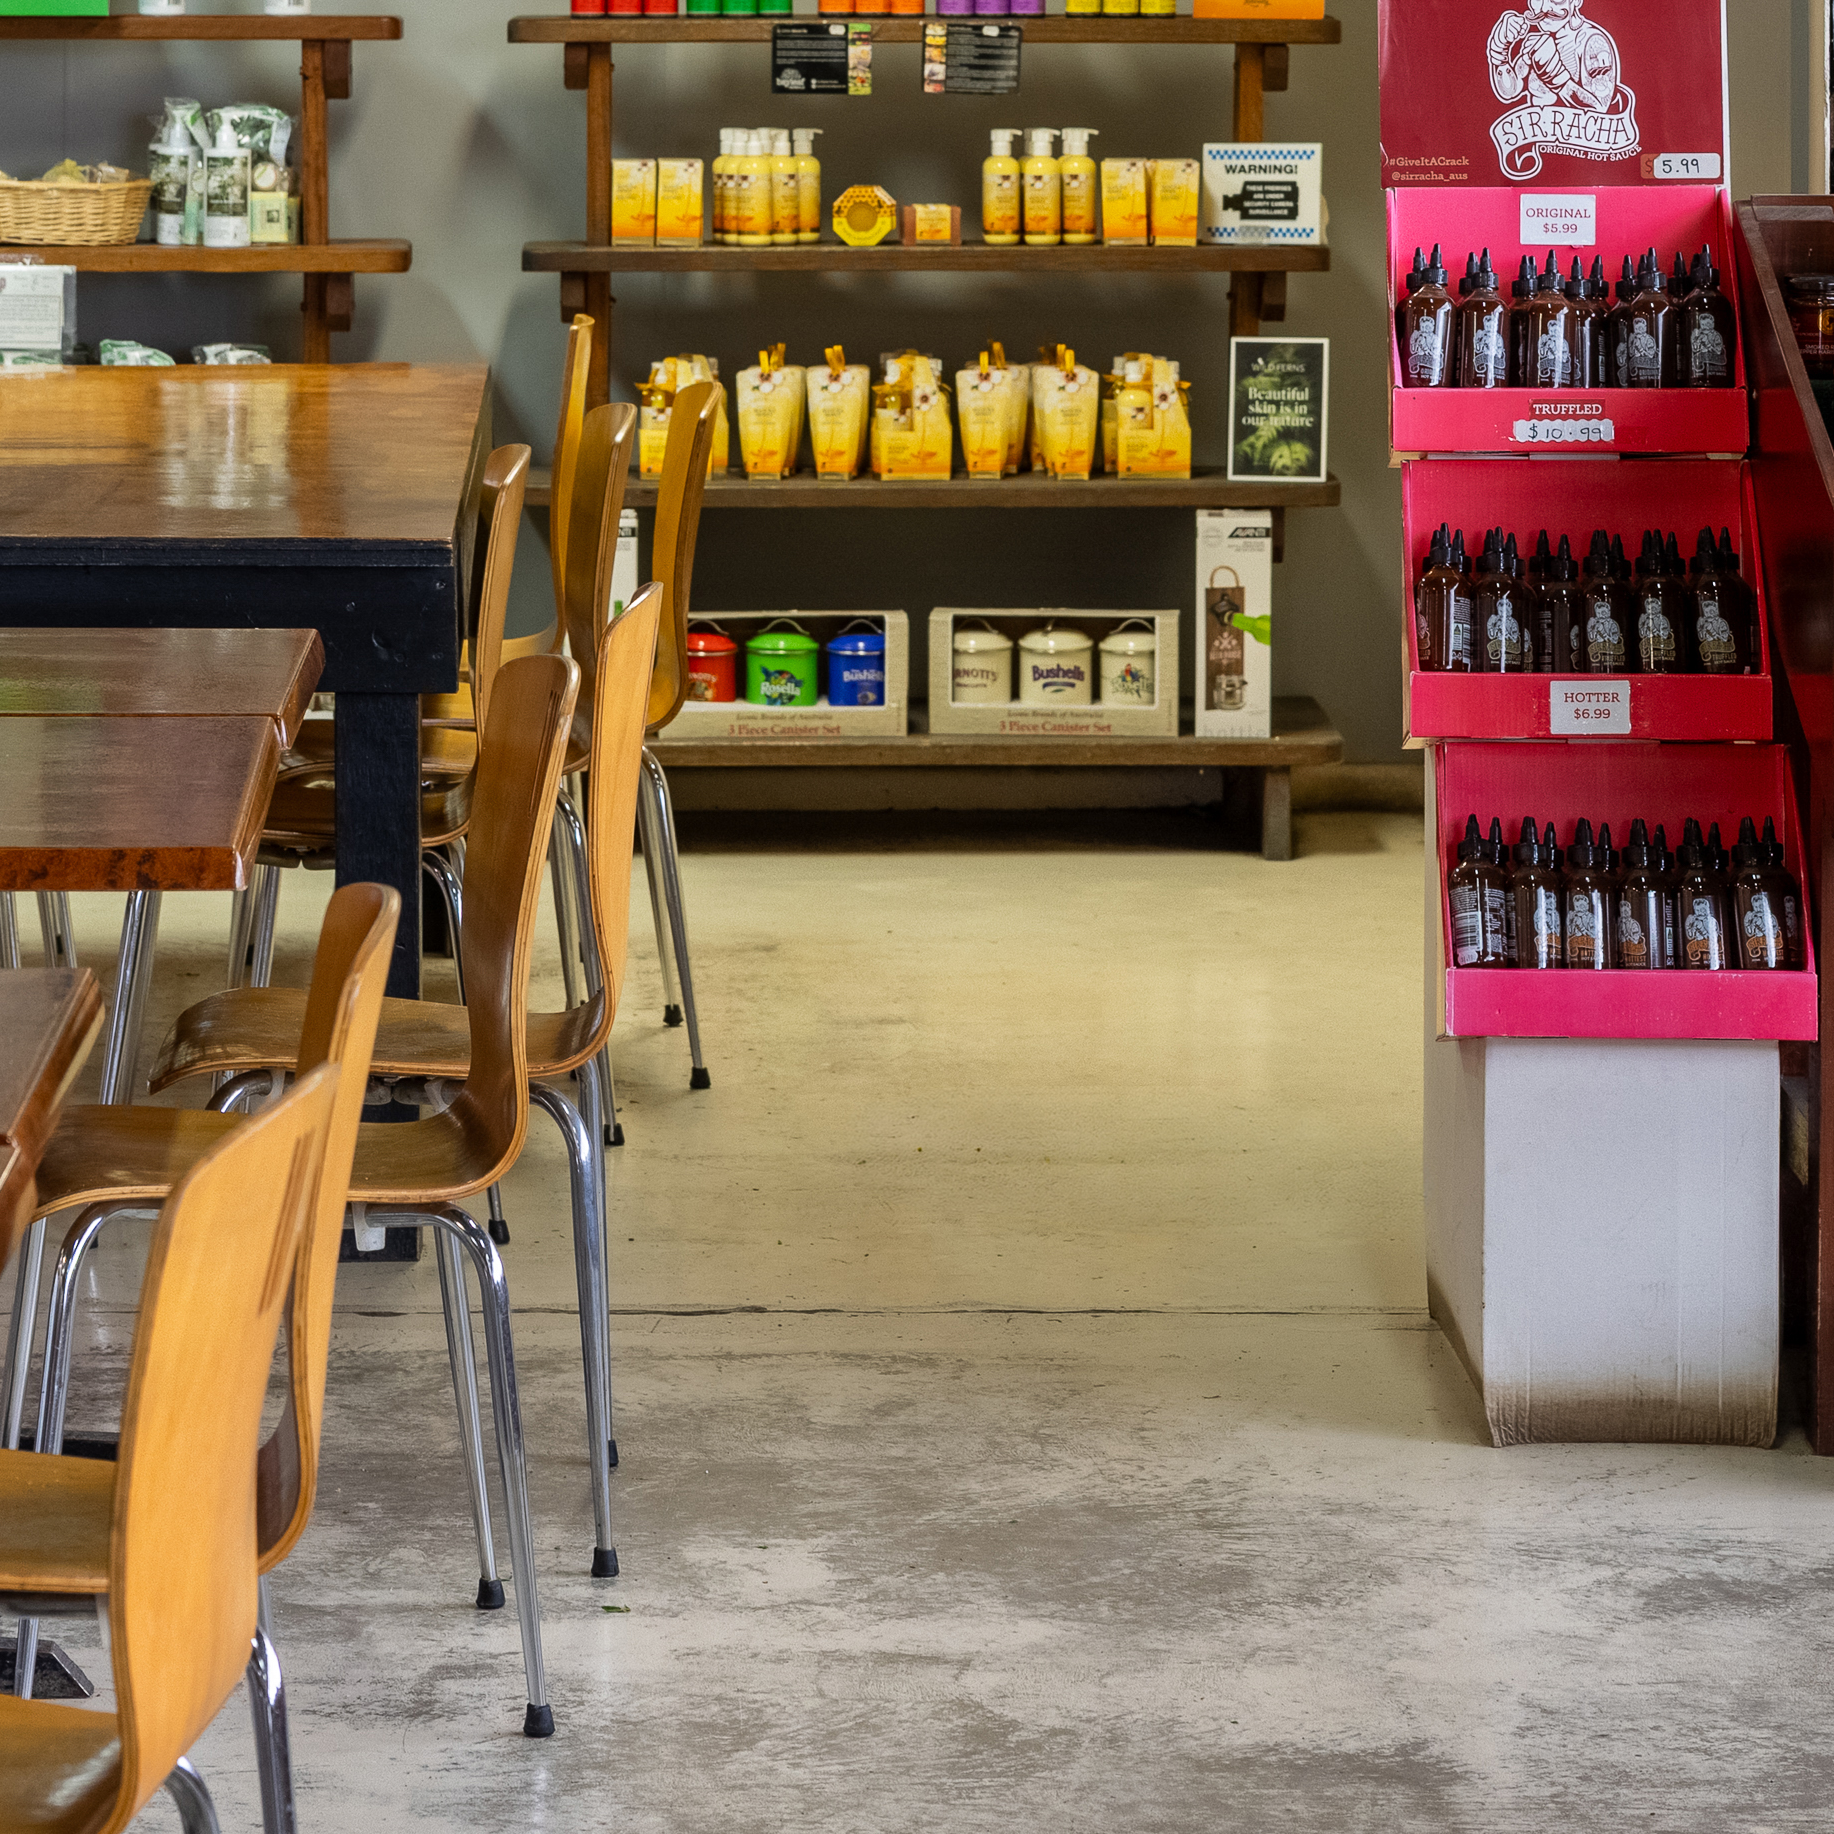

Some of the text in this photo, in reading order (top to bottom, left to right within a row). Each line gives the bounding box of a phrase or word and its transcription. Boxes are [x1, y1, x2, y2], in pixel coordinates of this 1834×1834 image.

[1539, 144, 1643, 162] ORIGINAL HOT SAUCE
[1389, 156, 1470, 167] #GiveItACrack
[1224, 164, 1298, 175] WARNING!
[1392, 170, 1468, 182] @sirracha_aus
[1525, 208, 1591, 219] ORIGINAL
[1542, 222, 1579, 235] $5.99
[1248, 387, 1310, 401] Beautiful
[1247, 401, 1308, 415] skin is in
[1532, 403, 1603, 415] TRUFFLED
[1241, 414, 1314, 427] our nature
[1031, 663, 1086, 684] Bushells
[760, 680, 801, 699] Rosella
[1563, 691, 1621, 704] HOTTER
[1573, 706, 1612, 721] $6.99
[1010, 720, 1112, 734] Piece Canister Set
